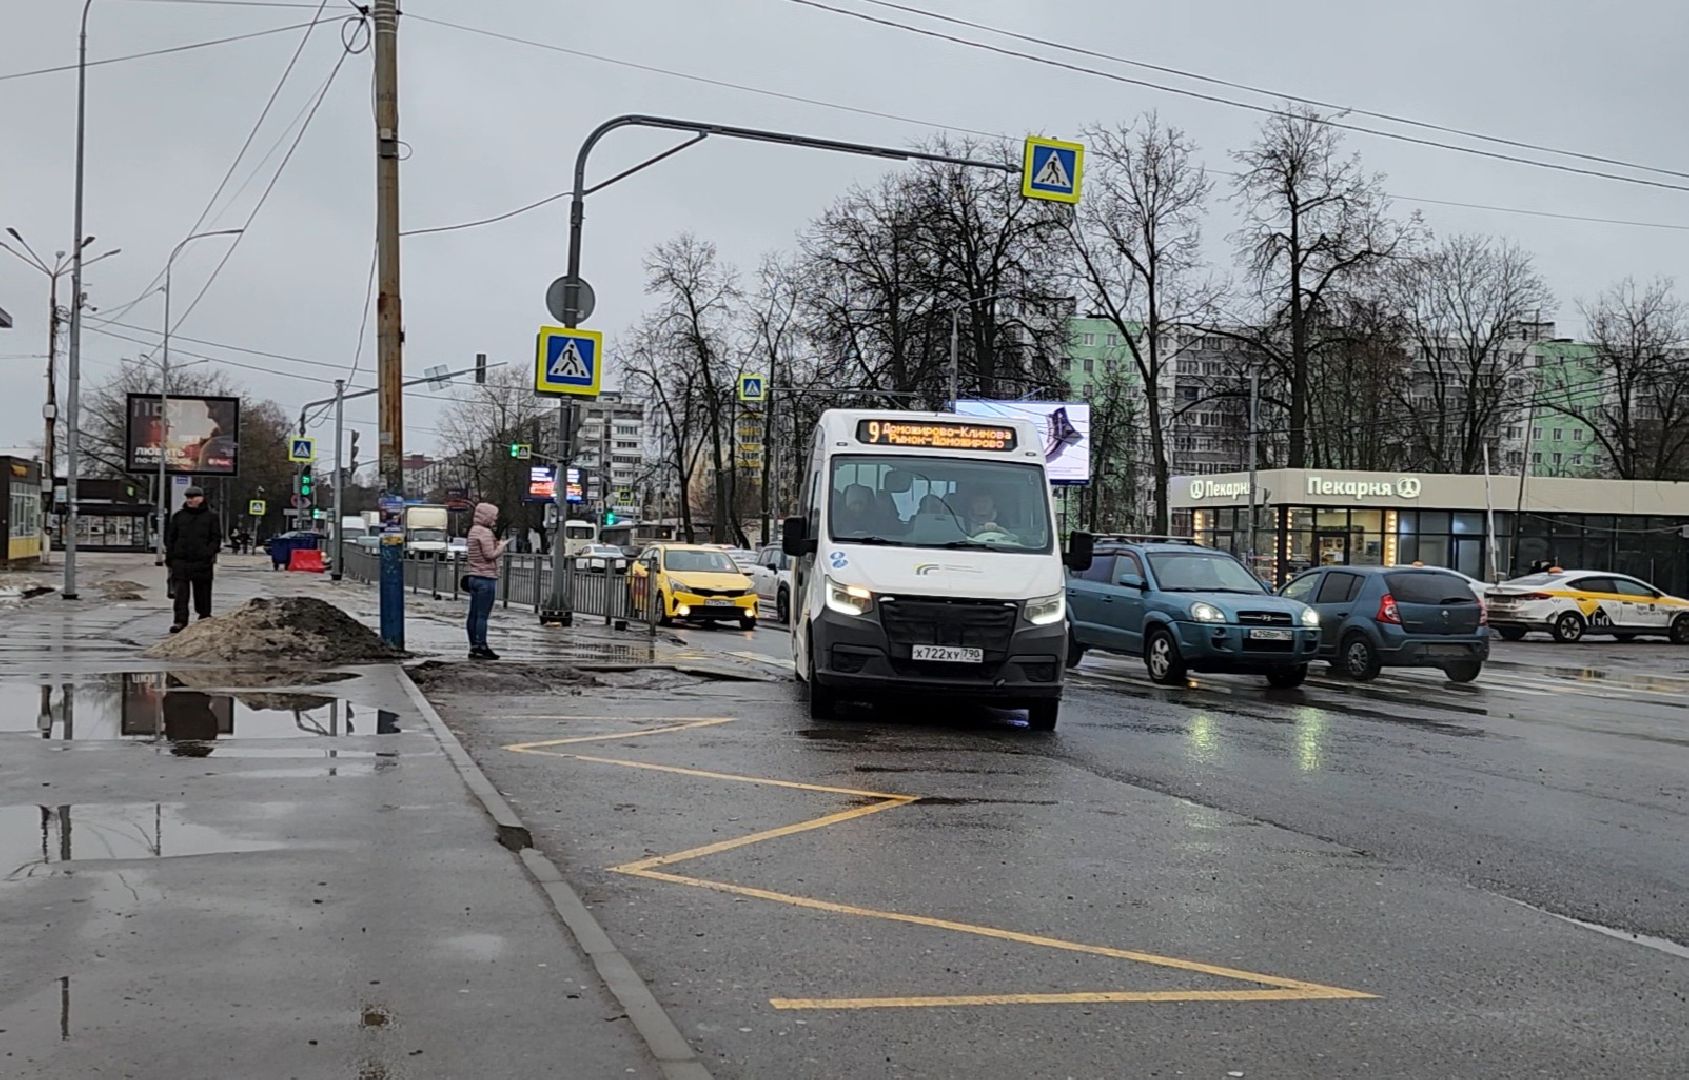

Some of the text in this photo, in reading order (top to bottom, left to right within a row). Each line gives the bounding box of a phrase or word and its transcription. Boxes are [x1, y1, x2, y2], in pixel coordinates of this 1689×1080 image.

[868, 421, 880, 443] 9
[1206, 481, 1250, 500] Пекарн
[1307, 476, 1393, 500] Пекарня
